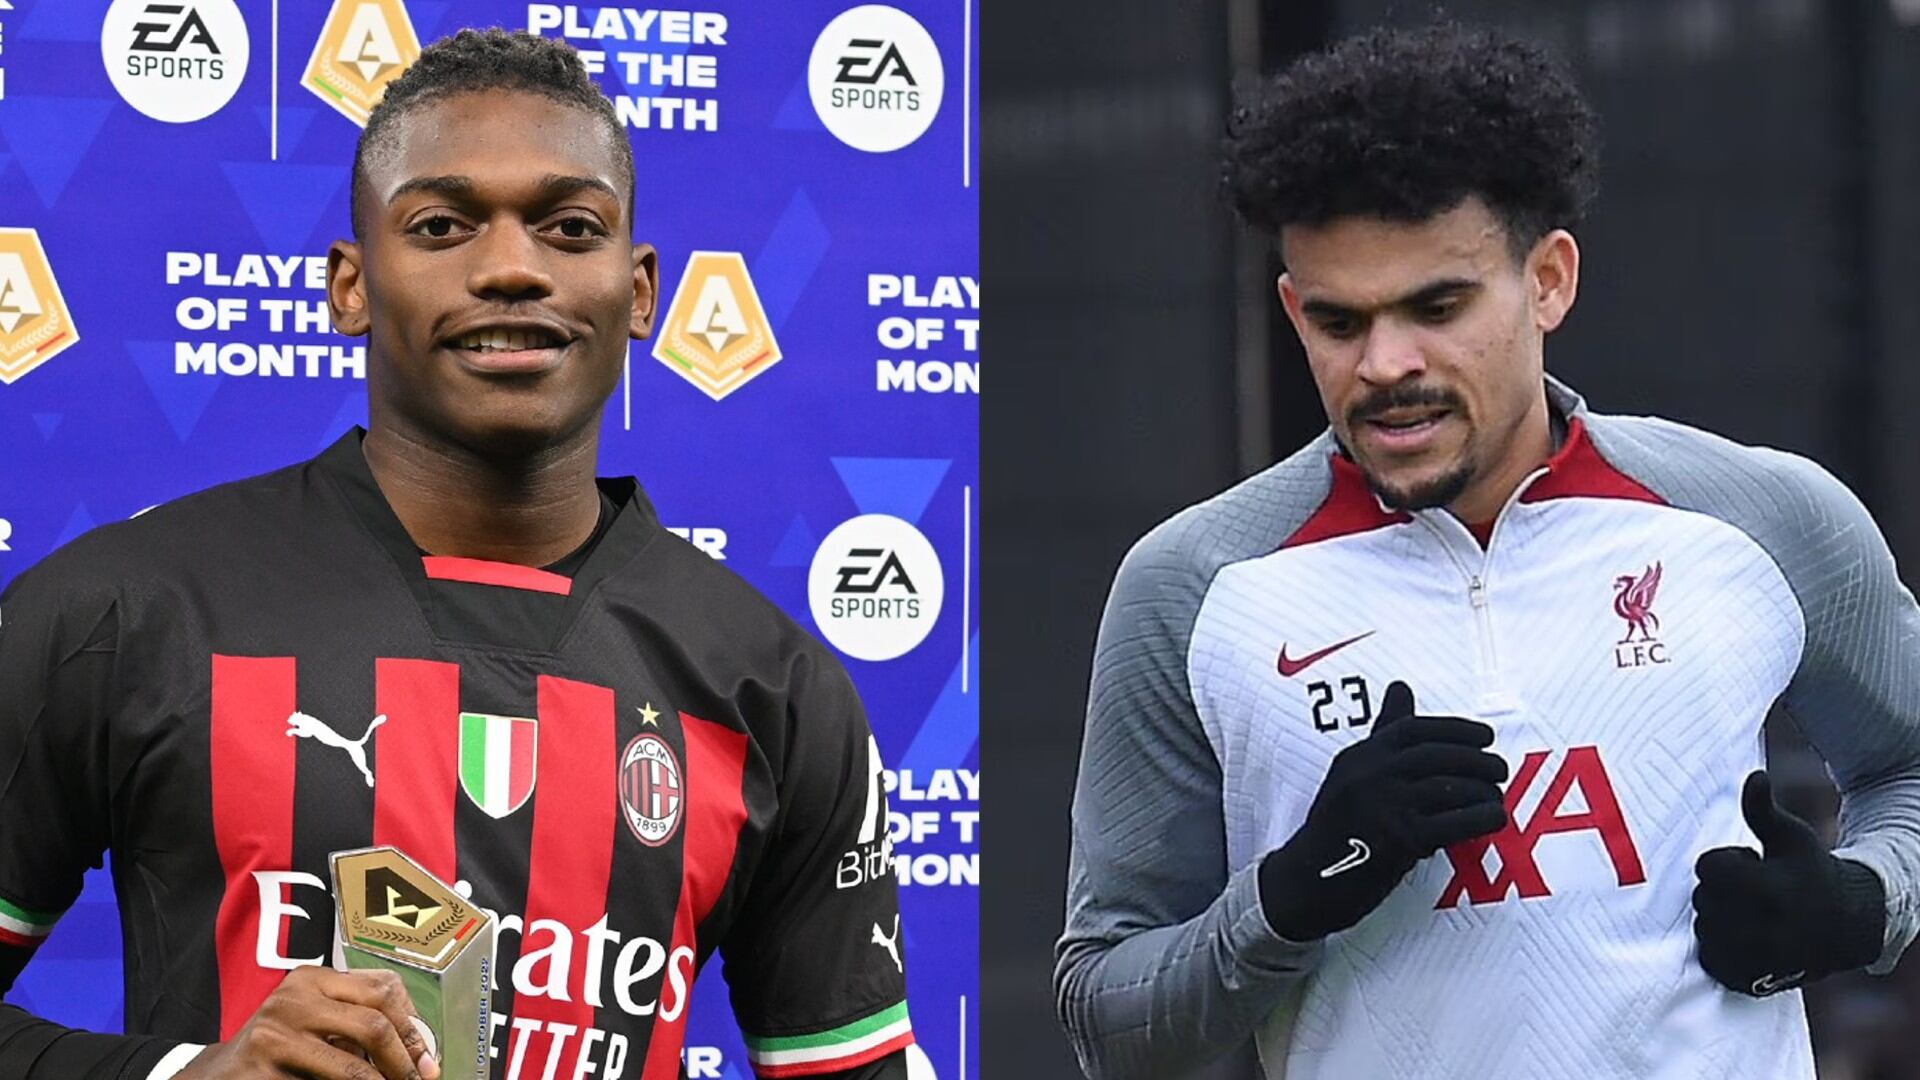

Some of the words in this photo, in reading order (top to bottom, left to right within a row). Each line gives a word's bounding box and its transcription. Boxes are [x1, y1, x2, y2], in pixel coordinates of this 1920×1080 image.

[129, 3, 221, 54] EA
[528, 4, 728, 45] PLAYER
[126, 55, 224, 80] SPORTS
[577, 50, 605, 80] F
[617, 52, 717, 88] THE
[834, 39, 918, 86] EA
[612, 95, 718, 131] NTH
[831, 88, 920, 111] SPORTS
[166, 252, 328, 289] PLAYE
[175, 297, 247, 331] OF
[260, 300, 338, 334] TH
[877, 316, 944, 350] OF
[175, 342, 366, 379] MONTH
[834, 548, 918, 594] EA
[831, 598, 920, 619] SPORTS
[1307, 676, 1372, 733] 23
[633, 742, 668, 763] ACM
[636, 817, 667, 833] 1899
[1433, 745, 1647, 910] XA
[251, 871, 695, 1022] Erates
[477, 998, 487, 1064] OCTOBER
